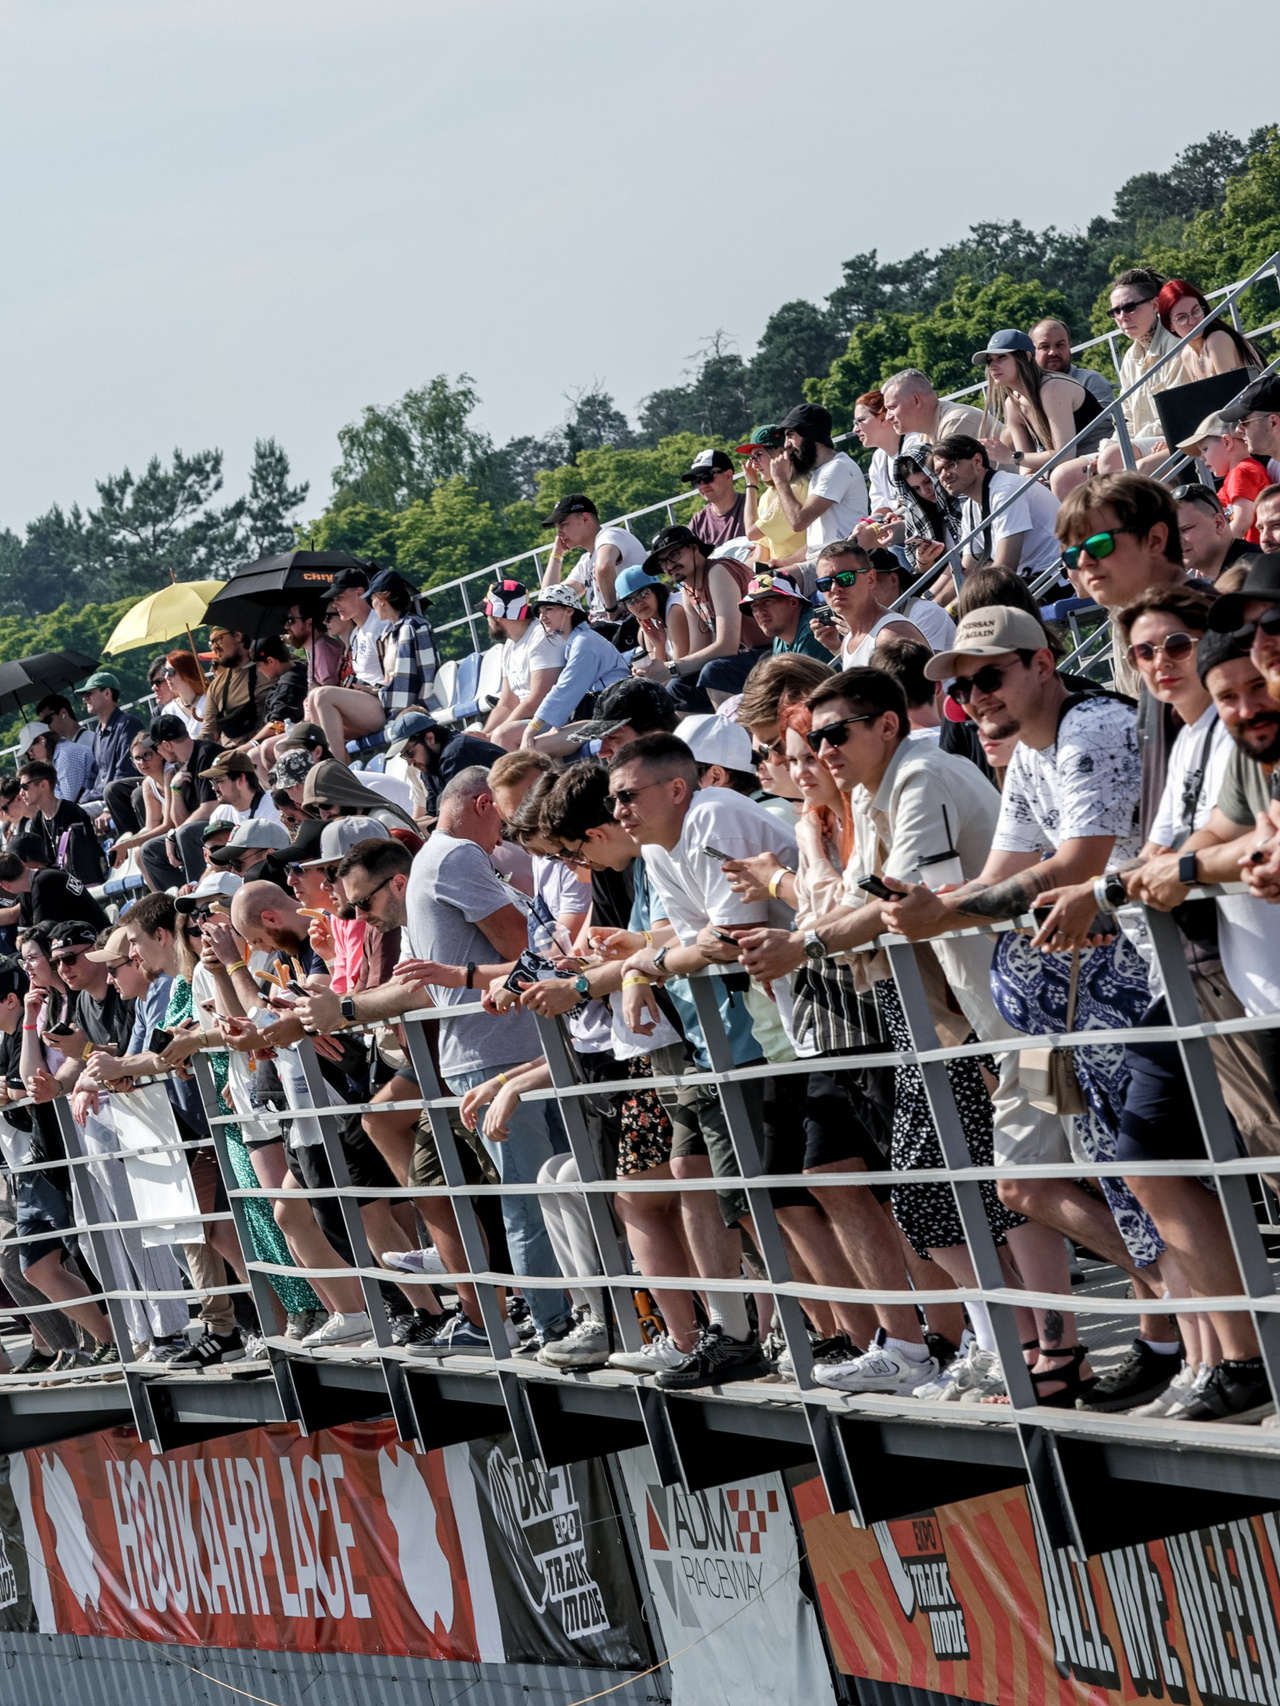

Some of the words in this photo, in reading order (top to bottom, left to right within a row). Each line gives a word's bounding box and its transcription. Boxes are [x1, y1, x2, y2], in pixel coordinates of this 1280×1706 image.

[963, 620, 996, 631] NISSAN
[965, 630, 995, 640] AGAIN
[105, 1454, 371, 1619] HOOKAHPLACE
[672, 1486, 738, 1552] ADM
[912, 1520, 937, 1551] EXPO
[680, 1555, 765, 1602] RACEWAY
[910, 1562, 957, 1606] TRACK
[562, 1587, 607, 1635] MODE
[929, 1609, 969, 1654] MODE
